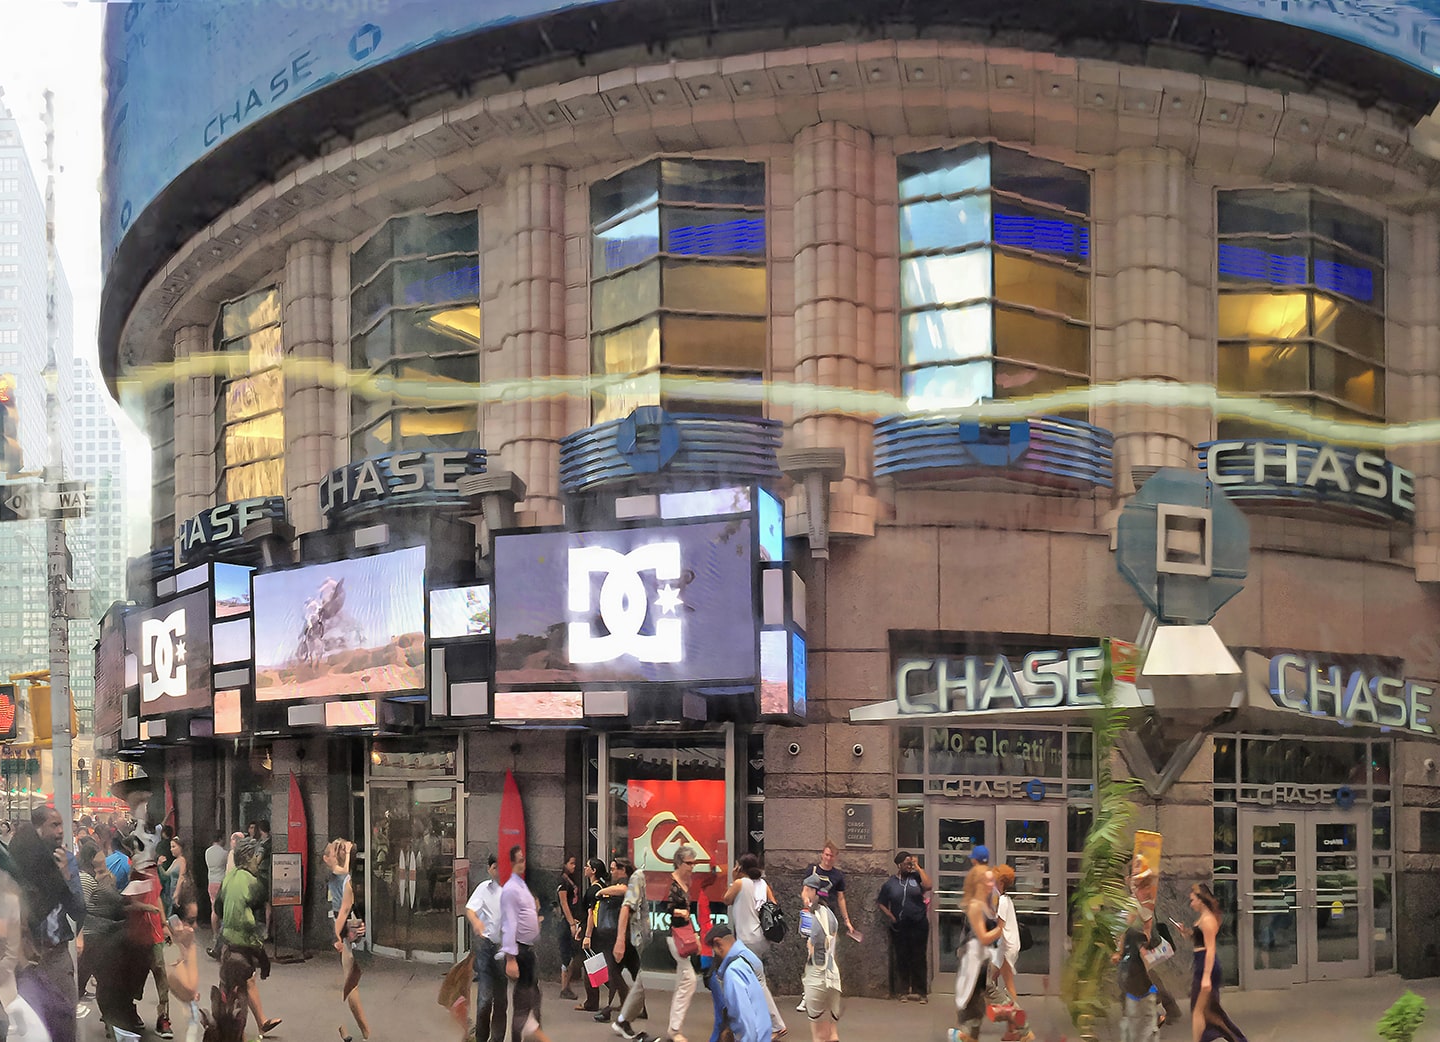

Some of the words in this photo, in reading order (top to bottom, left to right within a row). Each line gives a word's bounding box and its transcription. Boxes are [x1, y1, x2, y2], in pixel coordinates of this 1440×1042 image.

[203, 50, 313, 147] CHASE
[319, 451, 469, 515] CHASE
[1207, 442, 1416, 511] CHASE
[568, 542, 682, 663] DC
[142, 609, 187, 702] DC
[896, 648, 1105, 714] CHASE
[1269, 654, 1436, 734] CHASE
[943, 779, 1024, 799] CHASE
[1258, 786, 1333, 804] CHASE
